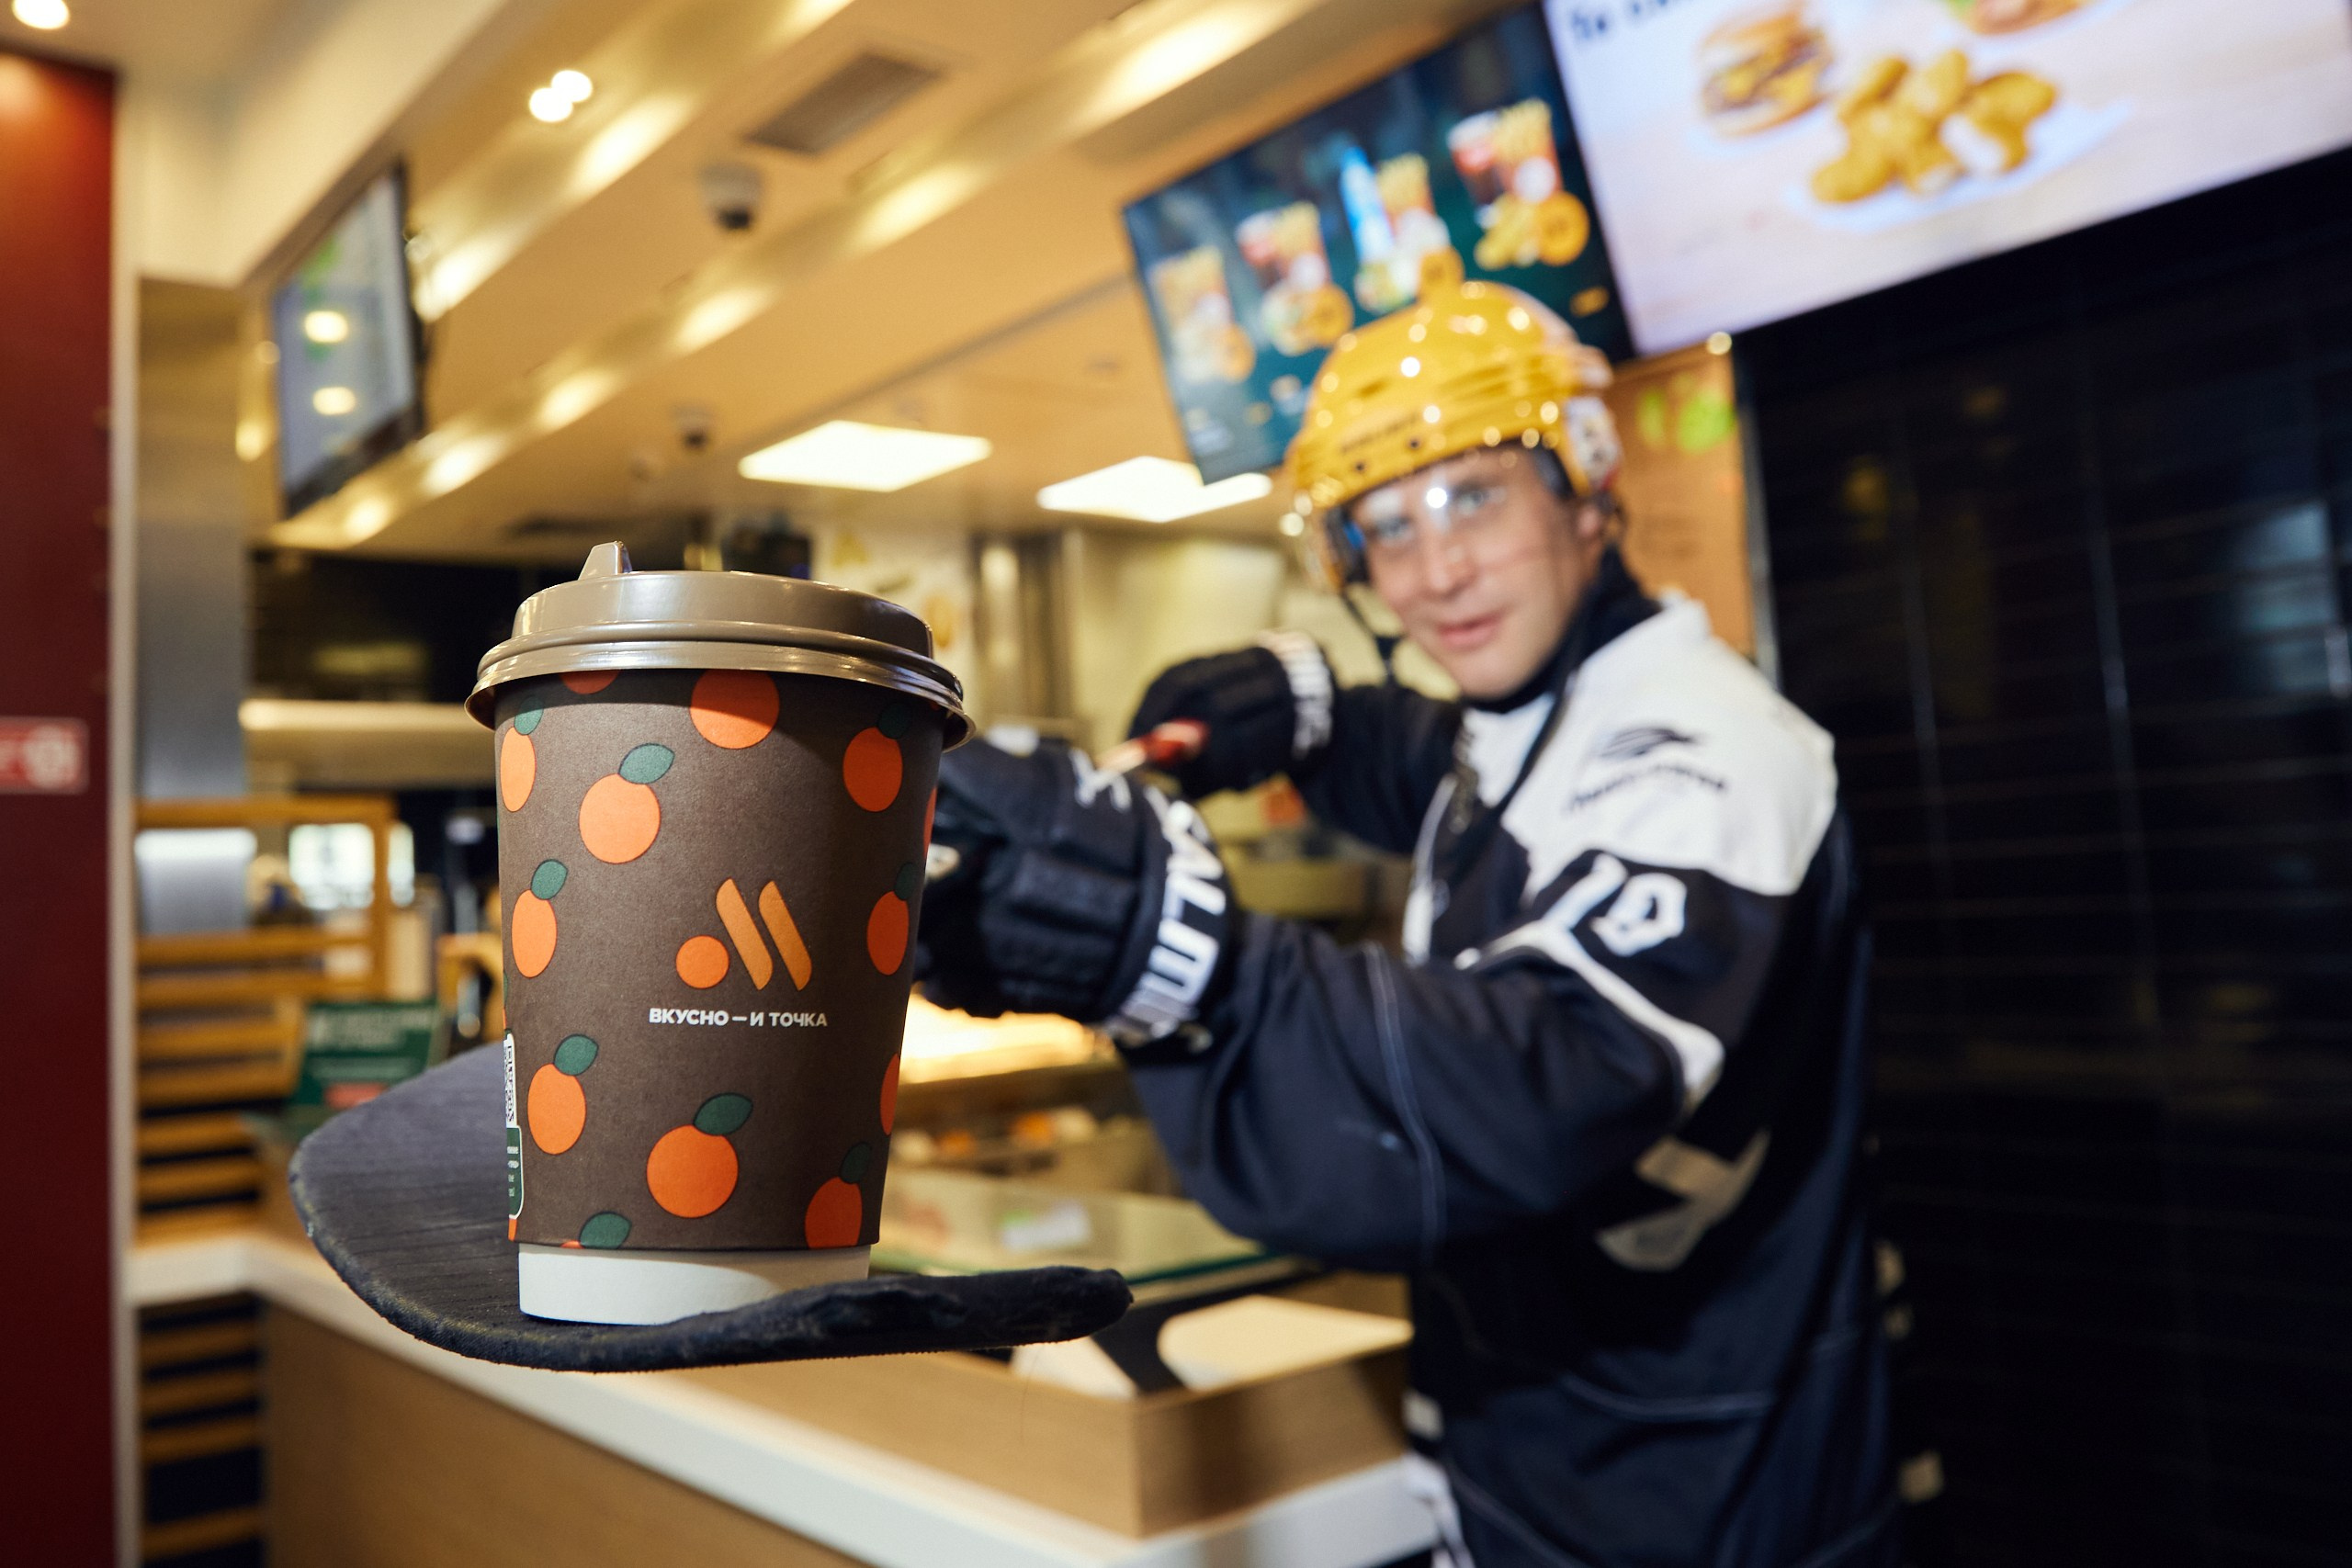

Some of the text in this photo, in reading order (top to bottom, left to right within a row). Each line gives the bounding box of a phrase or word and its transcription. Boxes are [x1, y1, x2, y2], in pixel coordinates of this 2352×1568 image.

[649, 1007, 729, 1026] ВКУСНО
[750, 1011, 764, 1027] И
[768, 1011, 828, 1027] ТОЧКА
